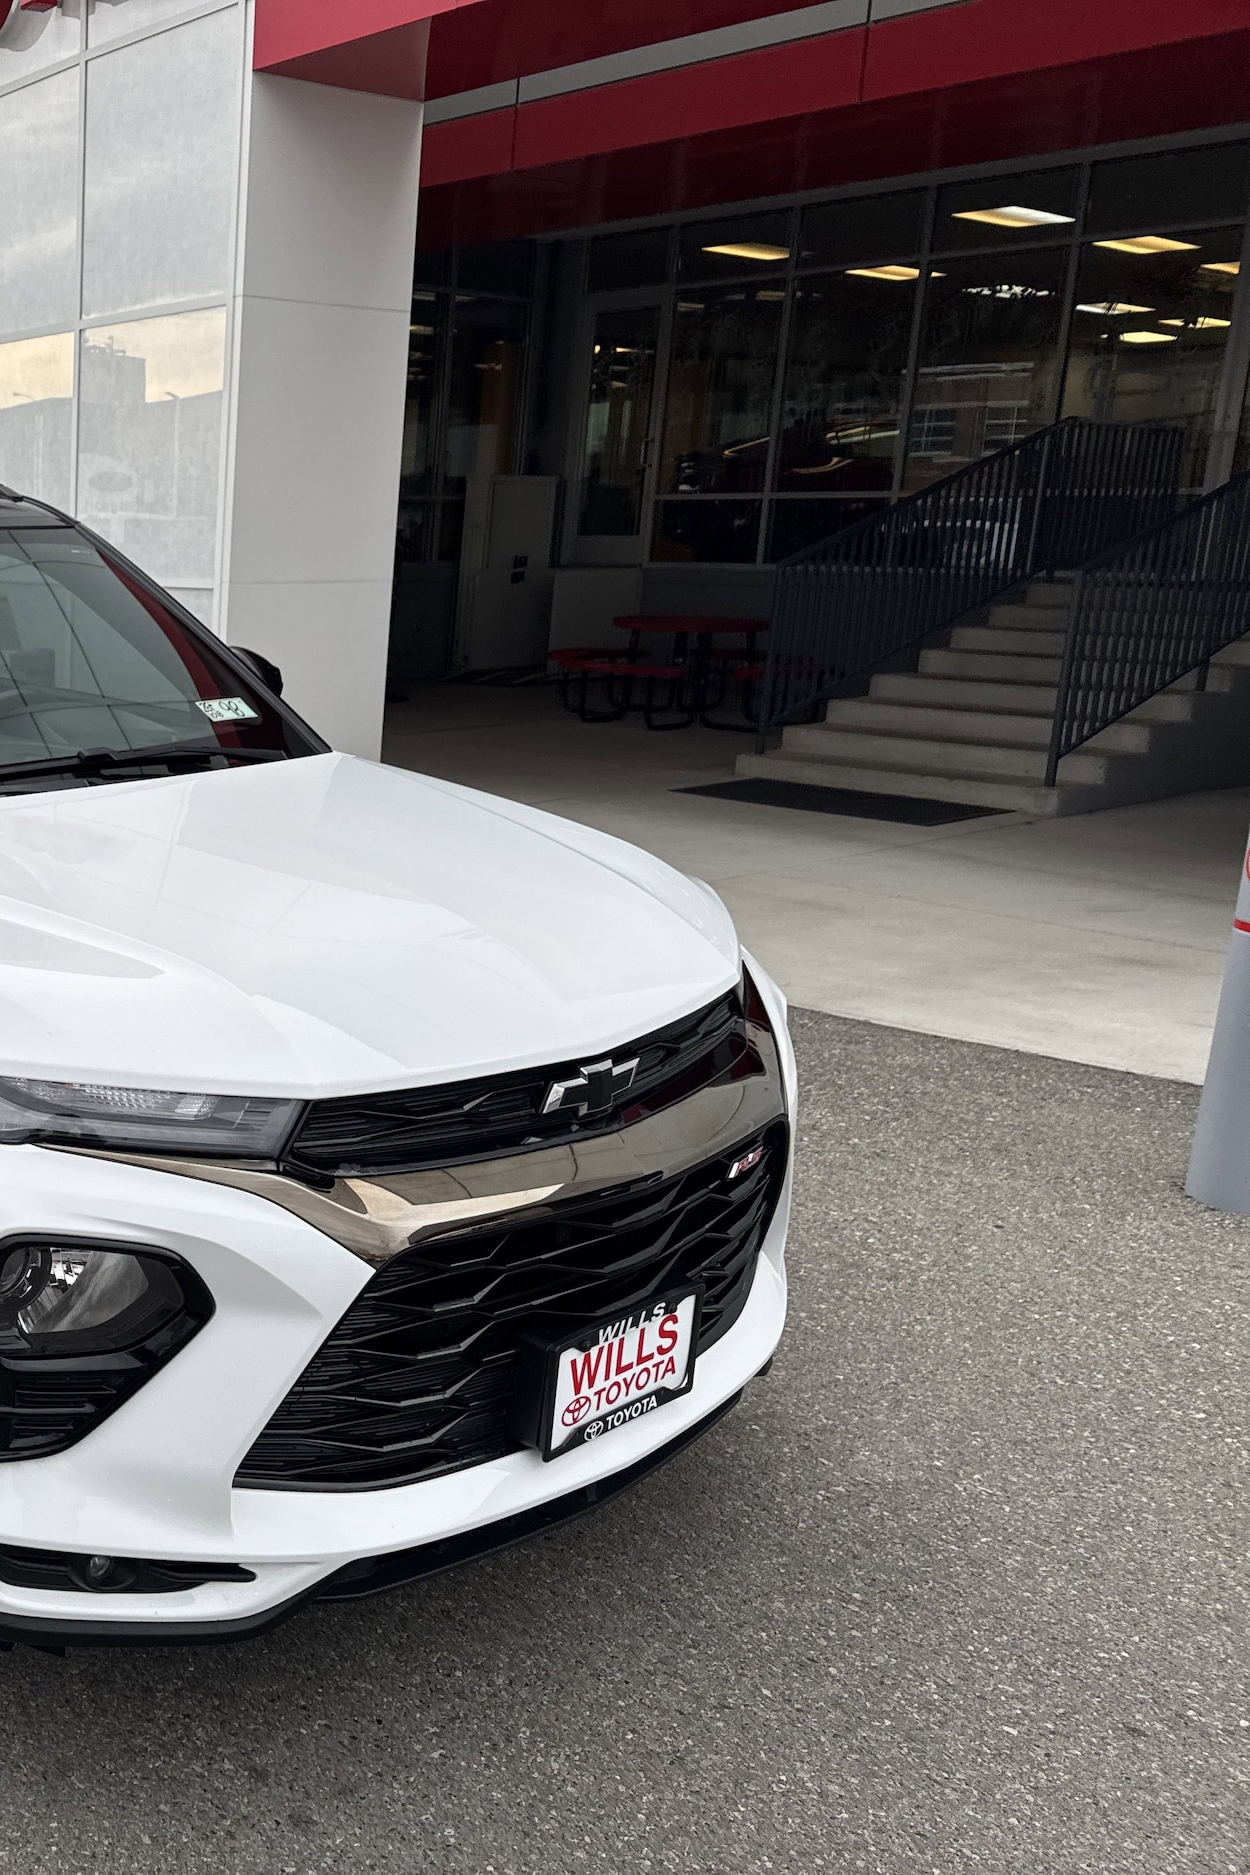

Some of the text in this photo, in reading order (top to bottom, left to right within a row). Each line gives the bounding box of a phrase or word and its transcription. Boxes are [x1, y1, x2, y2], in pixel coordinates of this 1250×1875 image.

[598, 1301, 667, 1345] WILLS
[570, 1313, 679, 1396] WILLS
[593, 1355, 676, 1411] TOYOTA
[606, 1395, 658, 1431] TOYOTA
